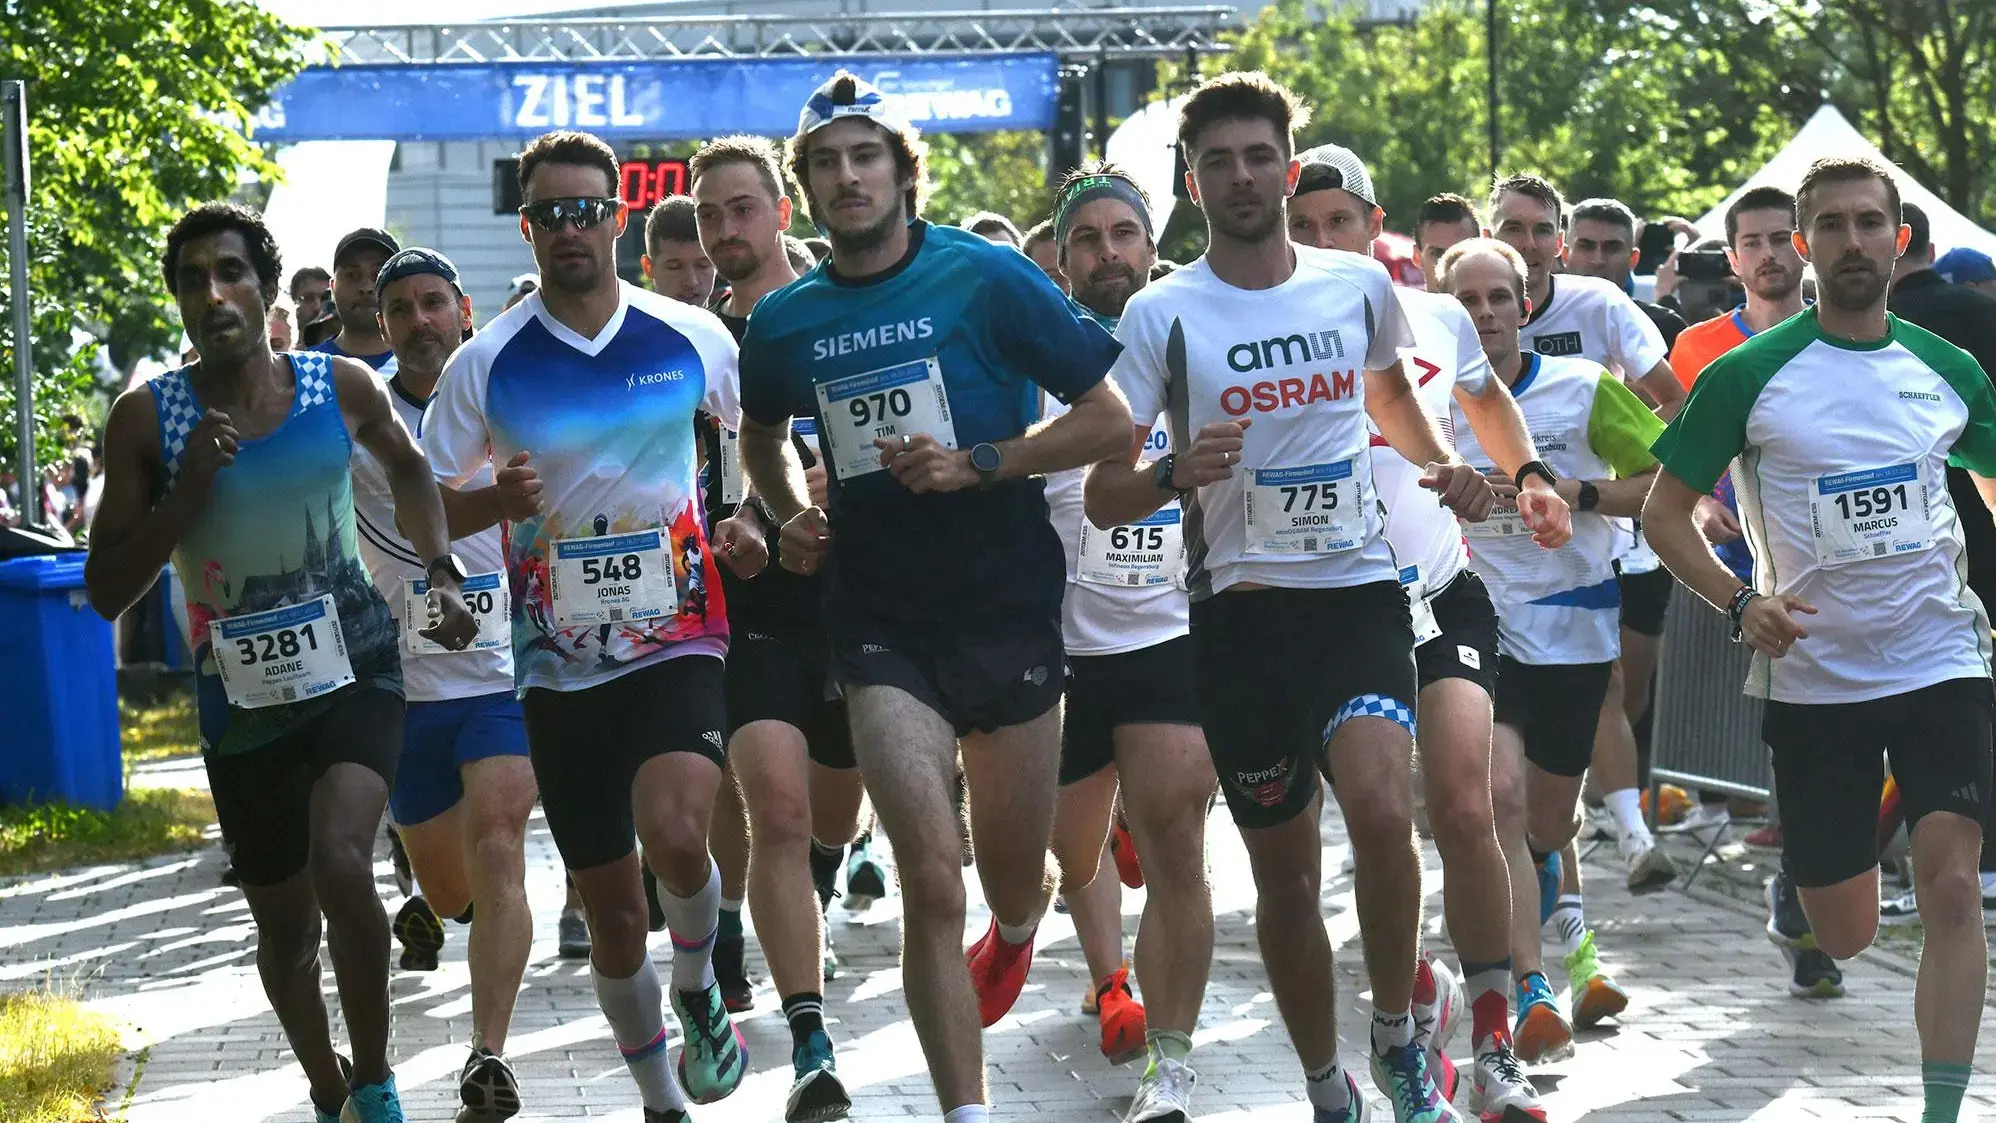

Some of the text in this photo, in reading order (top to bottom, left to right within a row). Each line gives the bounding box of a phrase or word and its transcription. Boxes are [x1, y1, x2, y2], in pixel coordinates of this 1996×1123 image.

[513, 74, 645, 127] ZIEL
[813, 316, 934, 361] SIEMENS
[1539, 336, 1578, 353] OTH
[639, 370, 684, 385] KRONES
[1221, 369, 1354, 416] OSRAM
[1898, 391, 1941, 401] SCHAEFFLER
[849, 388, 912, 427] 970
[874, 425, 896, 438] TIM
[1281, 483, 1338, 512] 775
[1834, 484, 1908, 520] 1591
[1492, 506, 1519, 514] NDRE
[1291, 515, 1329, 526] SIMON
[1853, 517, 1898, 532] MARCUS
[1111, 527, 1163, 550] 615
[1327, 540, 1354, 550] REWAG
[1895, 541, 1922, 552] REWAG
[1106, 552, 1163, 563] MAXIMILIAN
[582, 554, 642, 584] 548
[597, 585, 631, 598] JONAS
[462, 592, 493, 614] 60
[632, 608, 660, 620] REWAG
[236, 623, 317, 665] 3281
[265, 660, 303, 677] ADANE
[306, 681, 336, 696] REWAG
